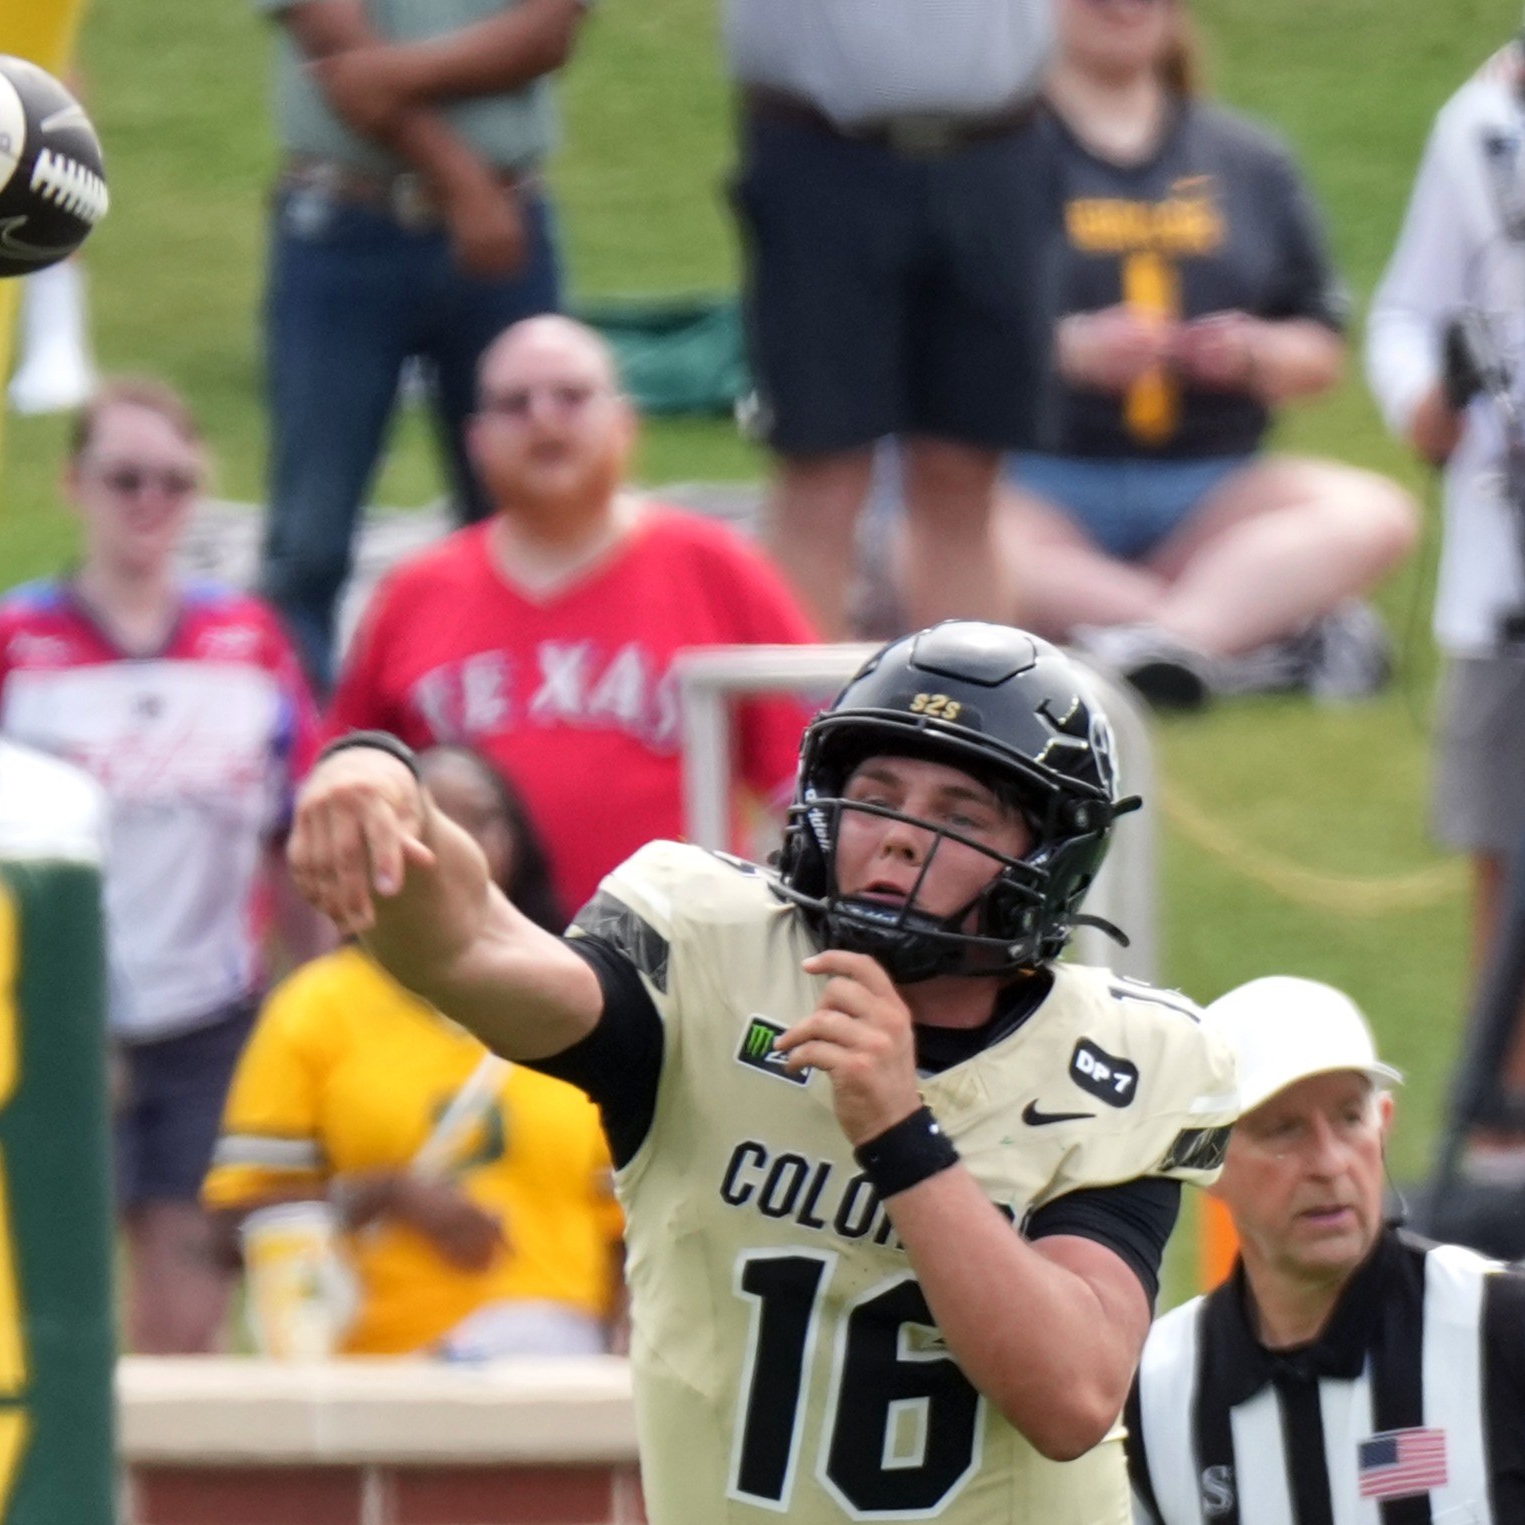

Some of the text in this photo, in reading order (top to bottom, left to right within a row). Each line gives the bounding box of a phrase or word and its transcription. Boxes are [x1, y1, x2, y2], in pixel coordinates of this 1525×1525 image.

[909, 692, 961, 720] s2s
[1075, 1049, 1132, 1094] DP 7
[720, 1140, 908, 1251] COLO
[726, 1245, 986, 1522] 16
[1200, 1465, 1234, 1517] S
